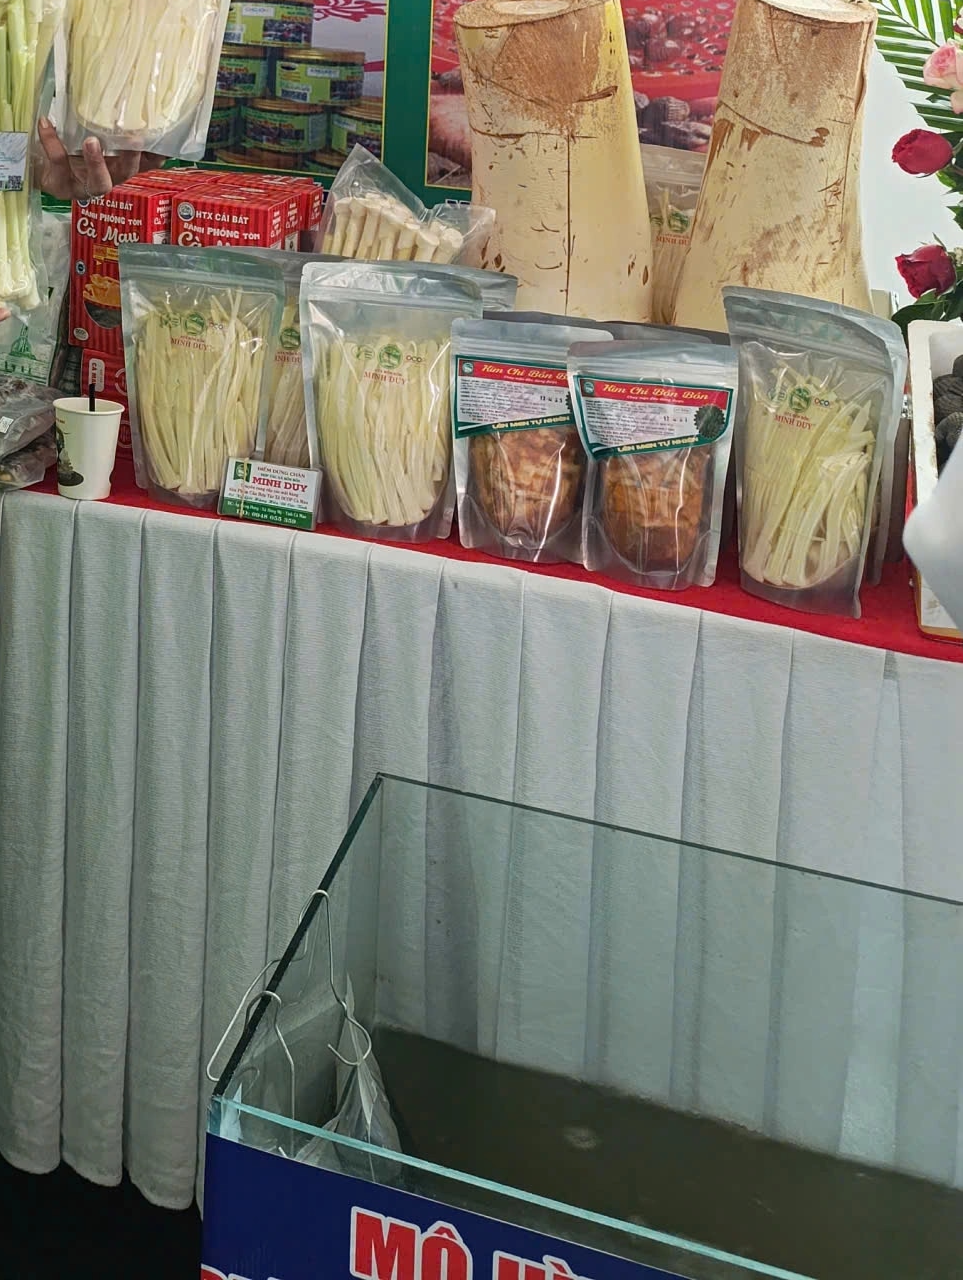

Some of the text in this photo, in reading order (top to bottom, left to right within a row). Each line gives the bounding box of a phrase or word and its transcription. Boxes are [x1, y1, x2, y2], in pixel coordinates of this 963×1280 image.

[195, 211, 249, 225] HTX CÁI BÁT
[76, 216, 140, 247] Cà Mau
[170, 337, 192, 349] MINH
[192, 341, 209, 352] DUY
[364, 371, 387, 381] MINH
[774, 413, 795, 426] MINH
[795, 420, 813, 430] DUY
[251, 476, 282, 489] MINH
[283, 481, 308, 493] DUY
[353, 1208, 472, 1280] MÔ
